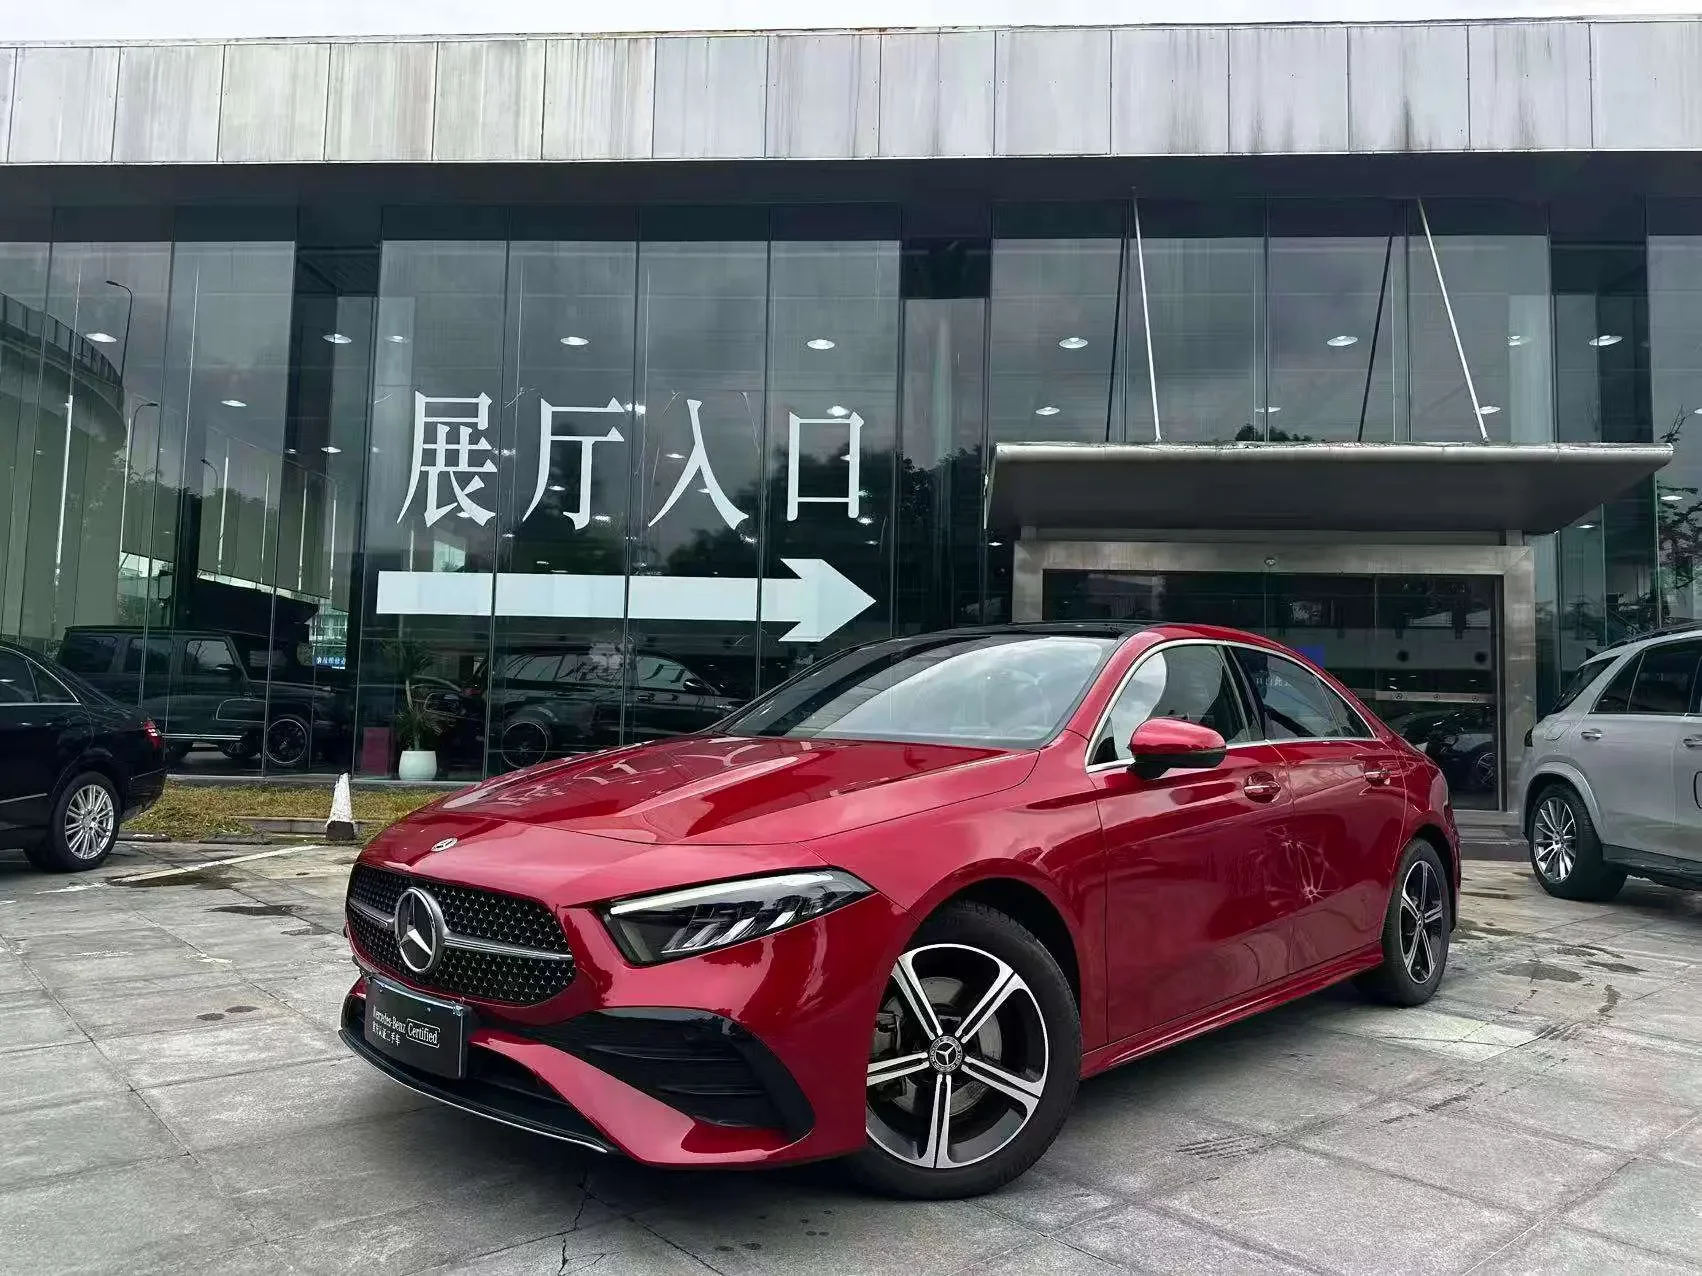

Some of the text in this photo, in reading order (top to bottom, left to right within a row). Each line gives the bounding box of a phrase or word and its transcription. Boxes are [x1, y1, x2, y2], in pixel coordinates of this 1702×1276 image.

[397, 390, 865, 531] 展厅入口
[408, 1022, 438, 1044] Certified
